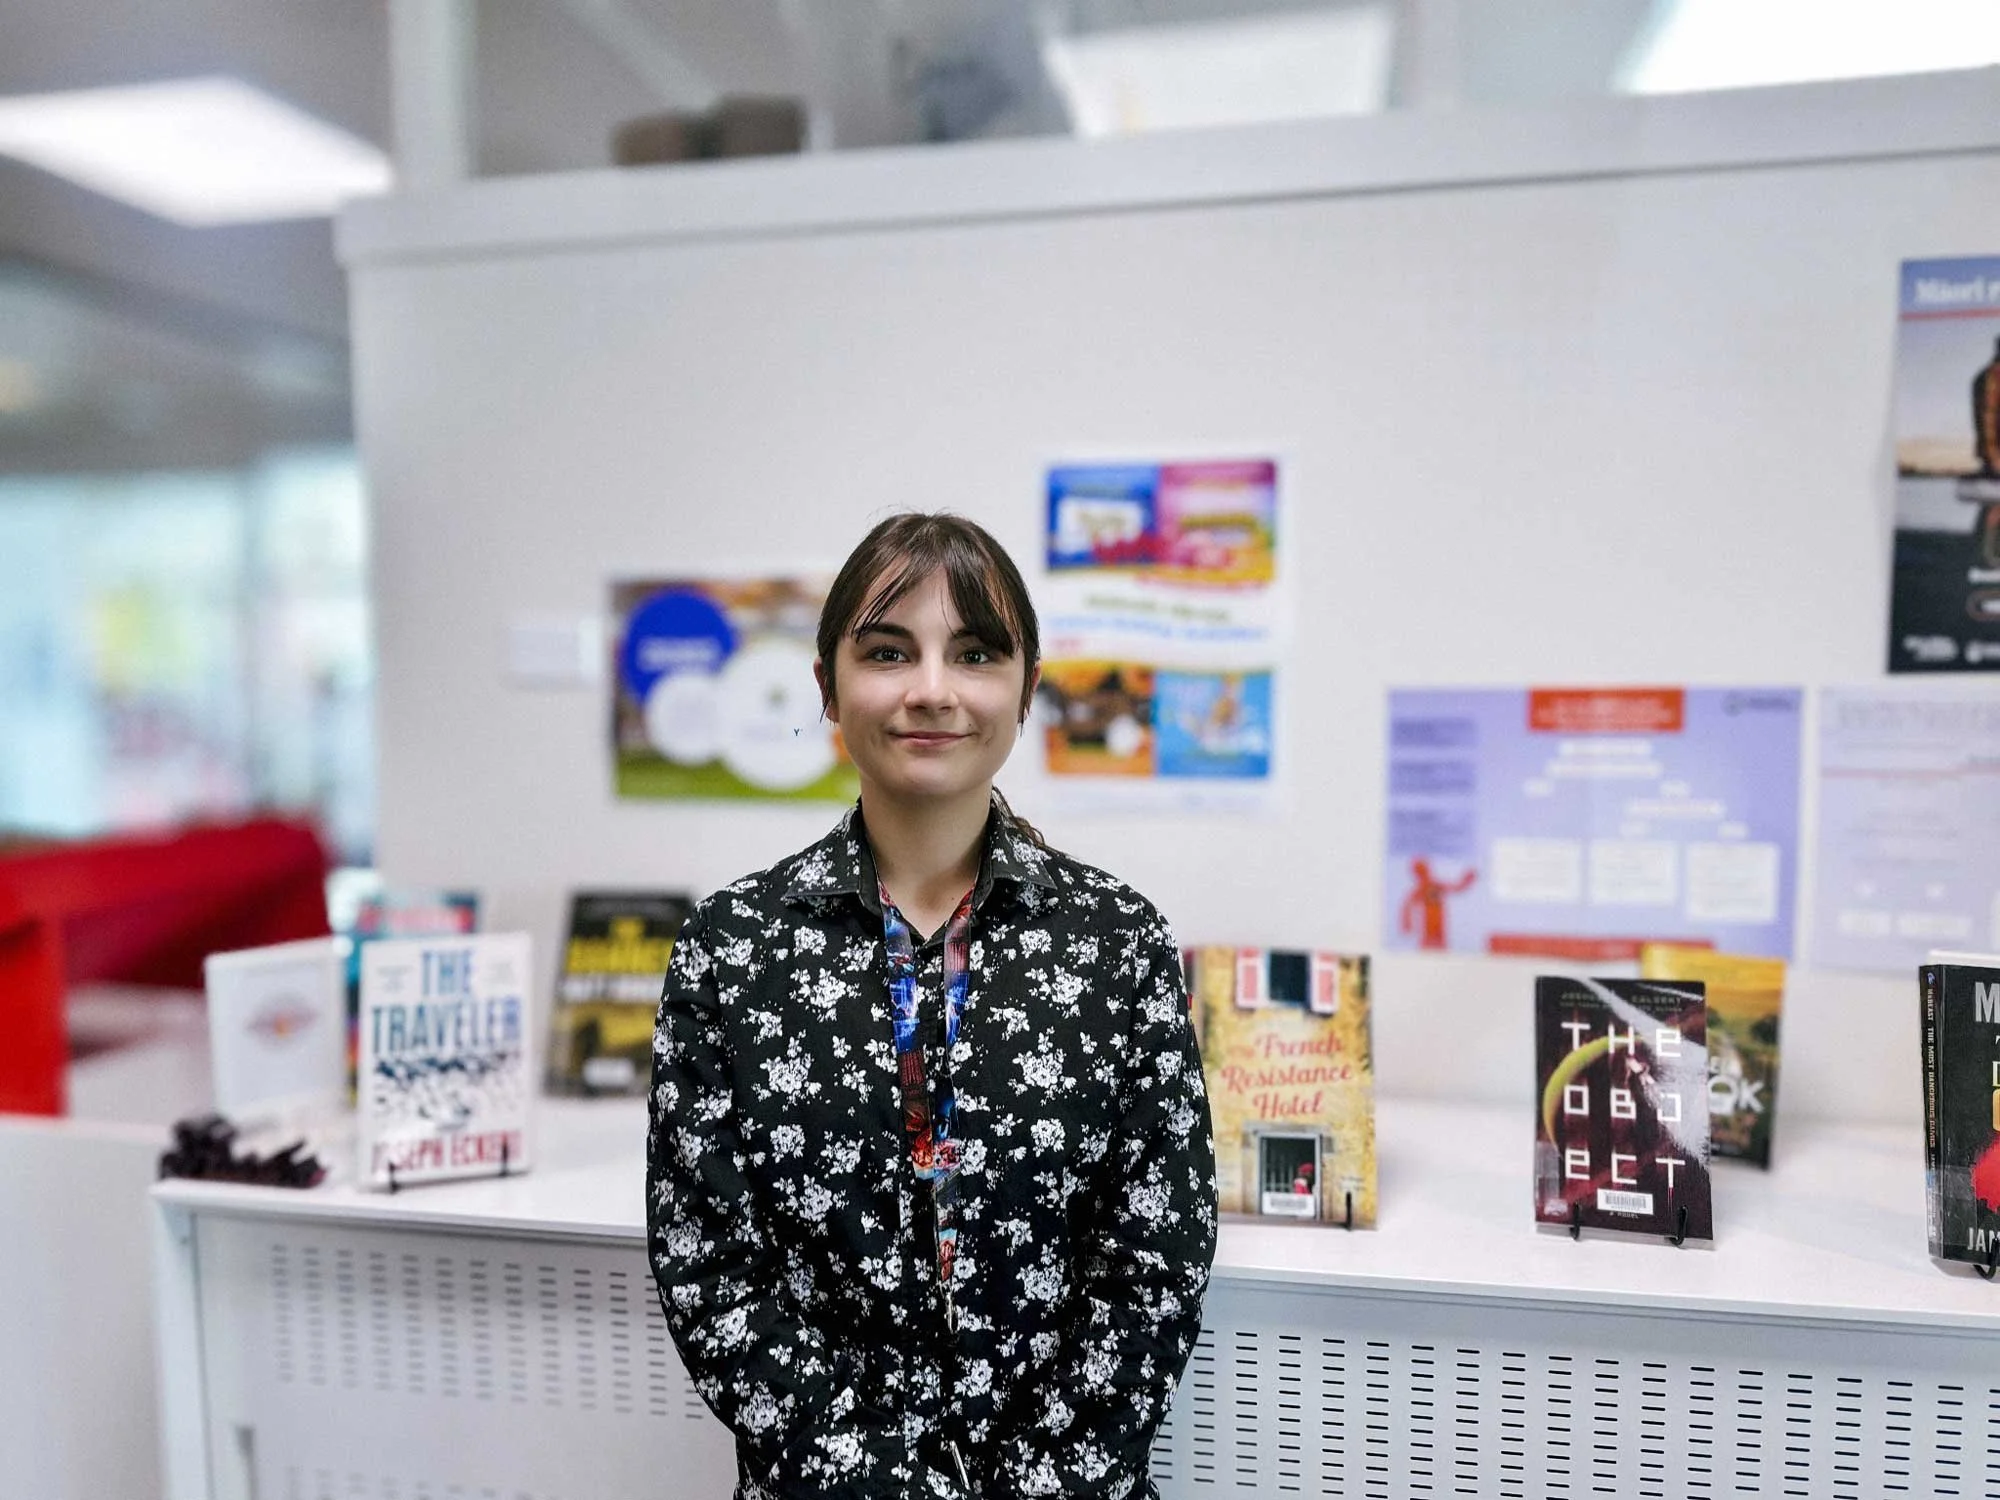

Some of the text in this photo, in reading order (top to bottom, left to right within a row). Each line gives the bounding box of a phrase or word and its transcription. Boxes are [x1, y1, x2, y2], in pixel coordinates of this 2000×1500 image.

[422, 949, 473, 995] THE
[373, 997, 521, 1053] TRAVELER
[1221, 1064, 1352, 1093] Resistance
[1253, 1091, 1323, 1118] Hotel
